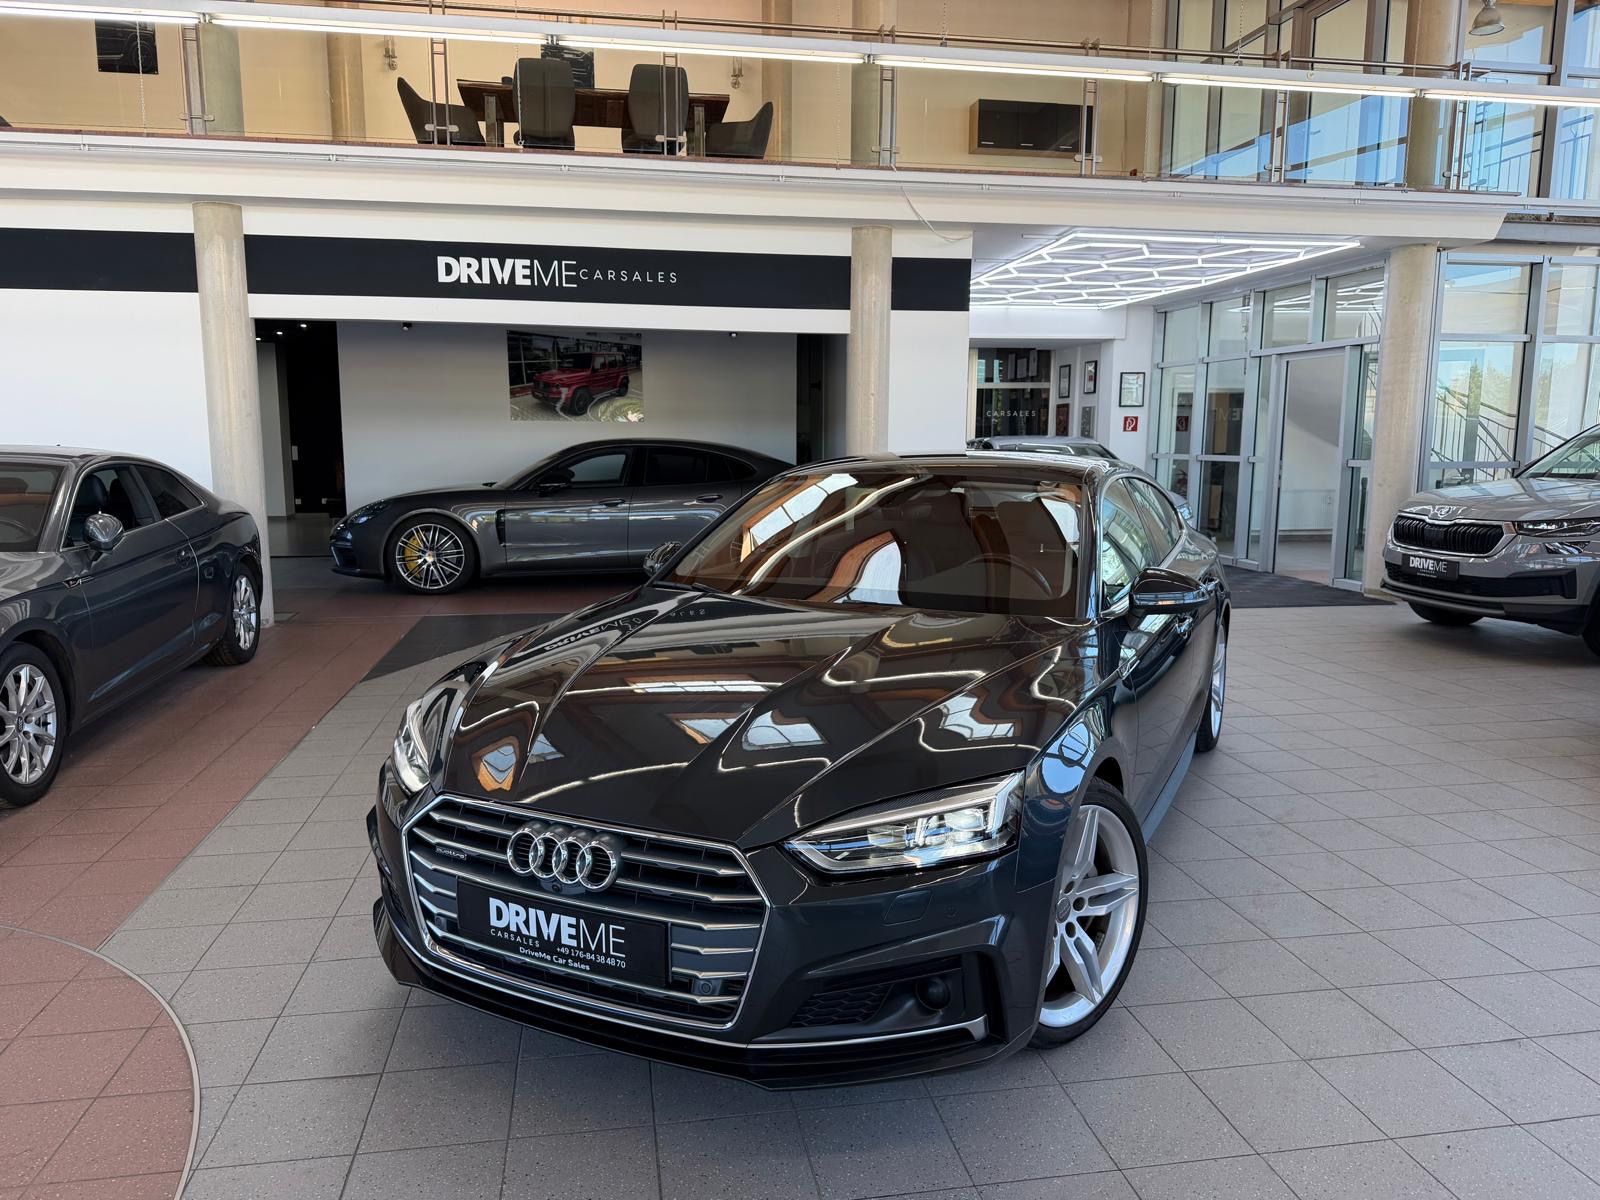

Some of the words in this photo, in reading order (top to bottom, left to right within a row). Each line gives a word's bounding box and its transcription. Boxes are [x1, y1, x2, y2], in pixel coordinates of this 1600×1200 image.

[579, 268, 677, 283] CARSALES
[490, 928, 540, 947] CARSALES
[519, 946, 551, 961] DriveMe
[552, 955, 566, 966] Car
[568, 959, 590, 971] Sales
[556, 946, 569, 955] +49
